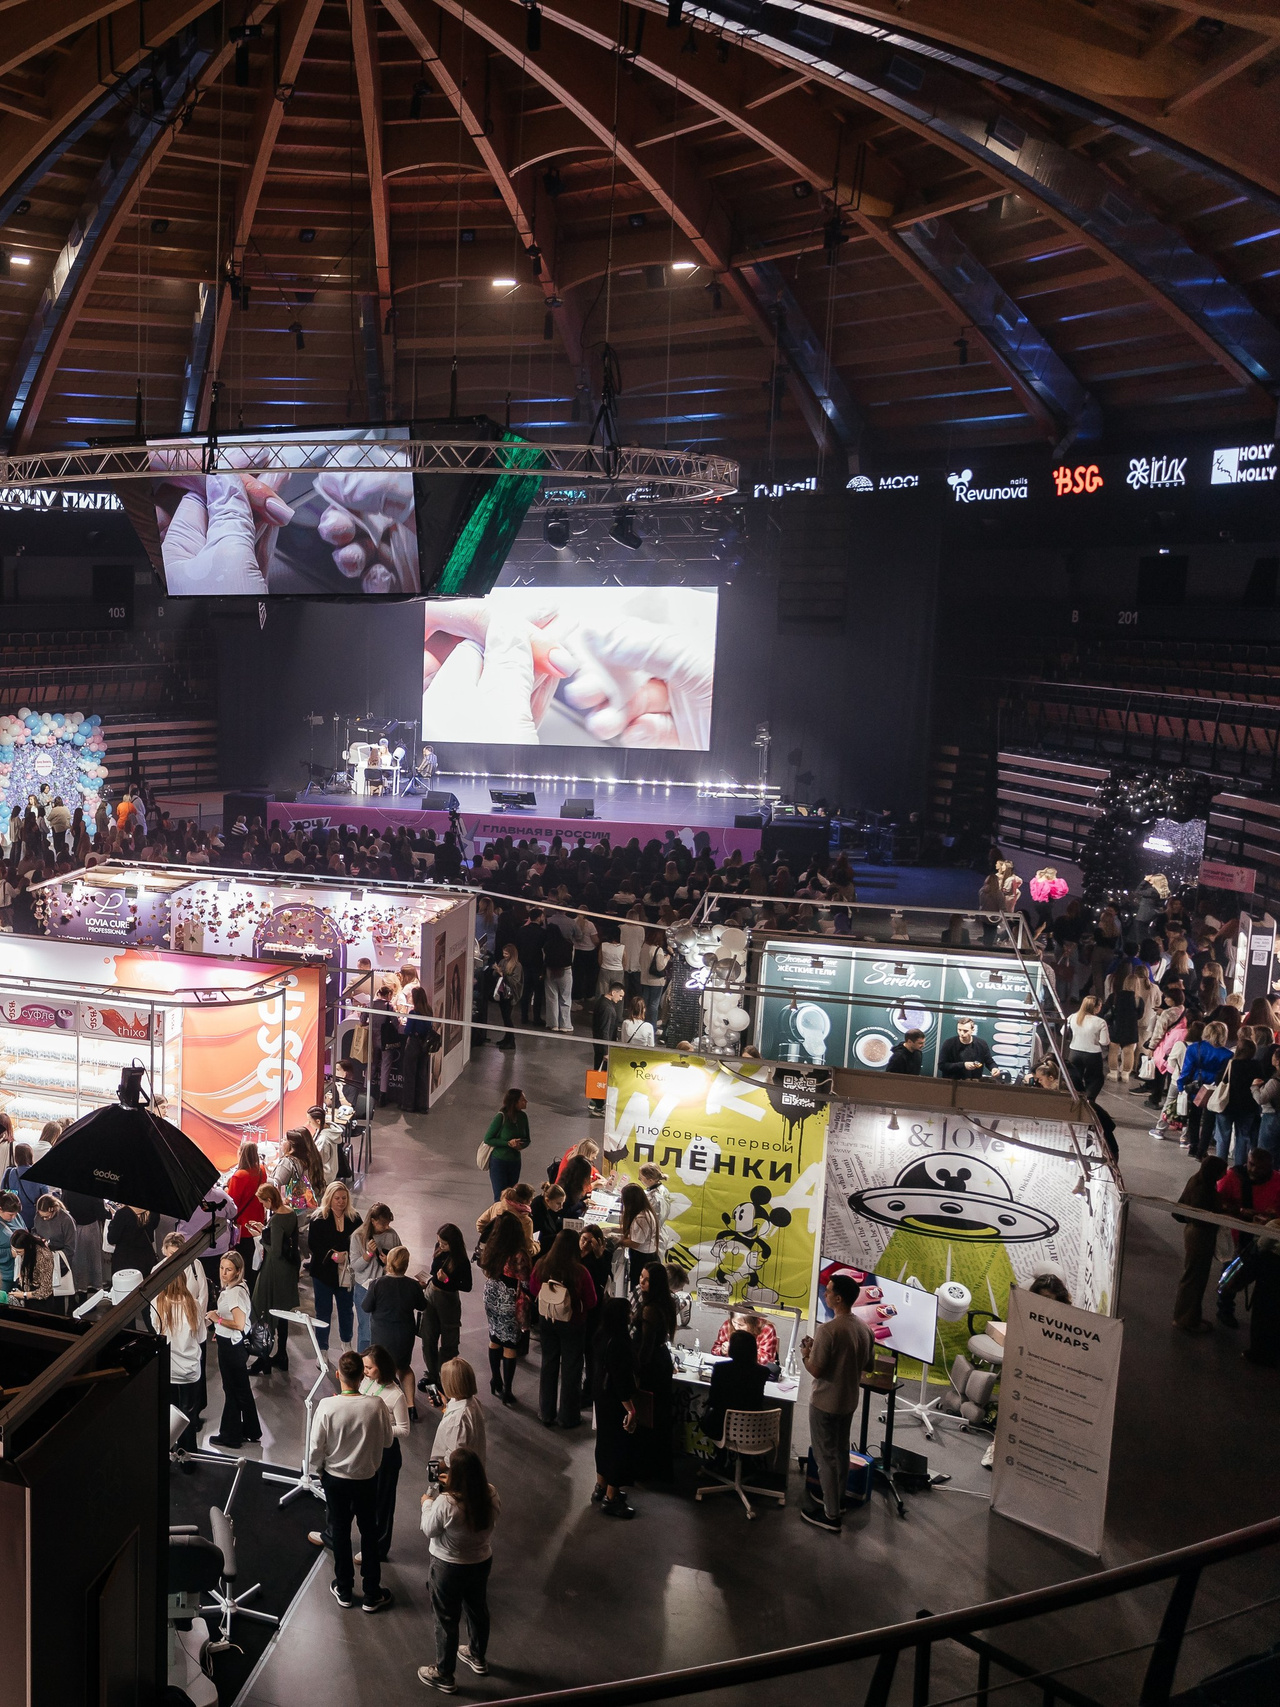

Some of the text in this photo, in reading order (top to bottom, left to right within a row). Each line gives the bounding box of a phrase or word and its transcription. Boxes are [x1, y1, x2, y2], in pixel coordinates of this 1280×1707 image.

[1238, 444, 1274, 461] HOLY
[1010, 477, 1028, 485] nails
[1052, 464, 1104, 496] BSG
[1236, 466, 1277, 483] MOLLY
[879, 475, 919, 490] MOOI
[955, 481, 1028, 503] Revunova
[108, 607, 125, 619] 103
[1118, 611, 1138, 624] 201
[483, 825, 544, 837] ГЛАВНАЯ
[557, 829, 610, 840] РОССИИ
[85, 917, 130, 929] LOVIA CURE
[88, 927, 127, 936] PROFESSIONAL
[777, 965, 814, 975] ЖЁСТКИЕ
[864, 962, 932, 989] Serebro
[984, 983, 1013, 991] БАЗАХ
[1014, 983, 1031, 993] ВСЁ
[21, 1009, 55, 1021] суфле
[117, 1025, 146, 1038] thixo
[635, 1124, 794, 1154] любовь с первой
[633, 1142, 793, 1184] ПЛЁНКИ
[93, 1168, 120, 1182] Godox
[1029, 1311, 1101, 1342] REVUNOVA
[1042, 1328, 1089, 1351] WRAPS
[1018, 1346, 1024, 1356] 1
[1014, 1368, 1023, 1379] 2
[1012, 1390, 1021, 1400] 3
[1009, 1412, 1018, 1423] 4
[1008, 1433, 1016, 1444] 5
[1005, 1455, 1014, 1466] 6
